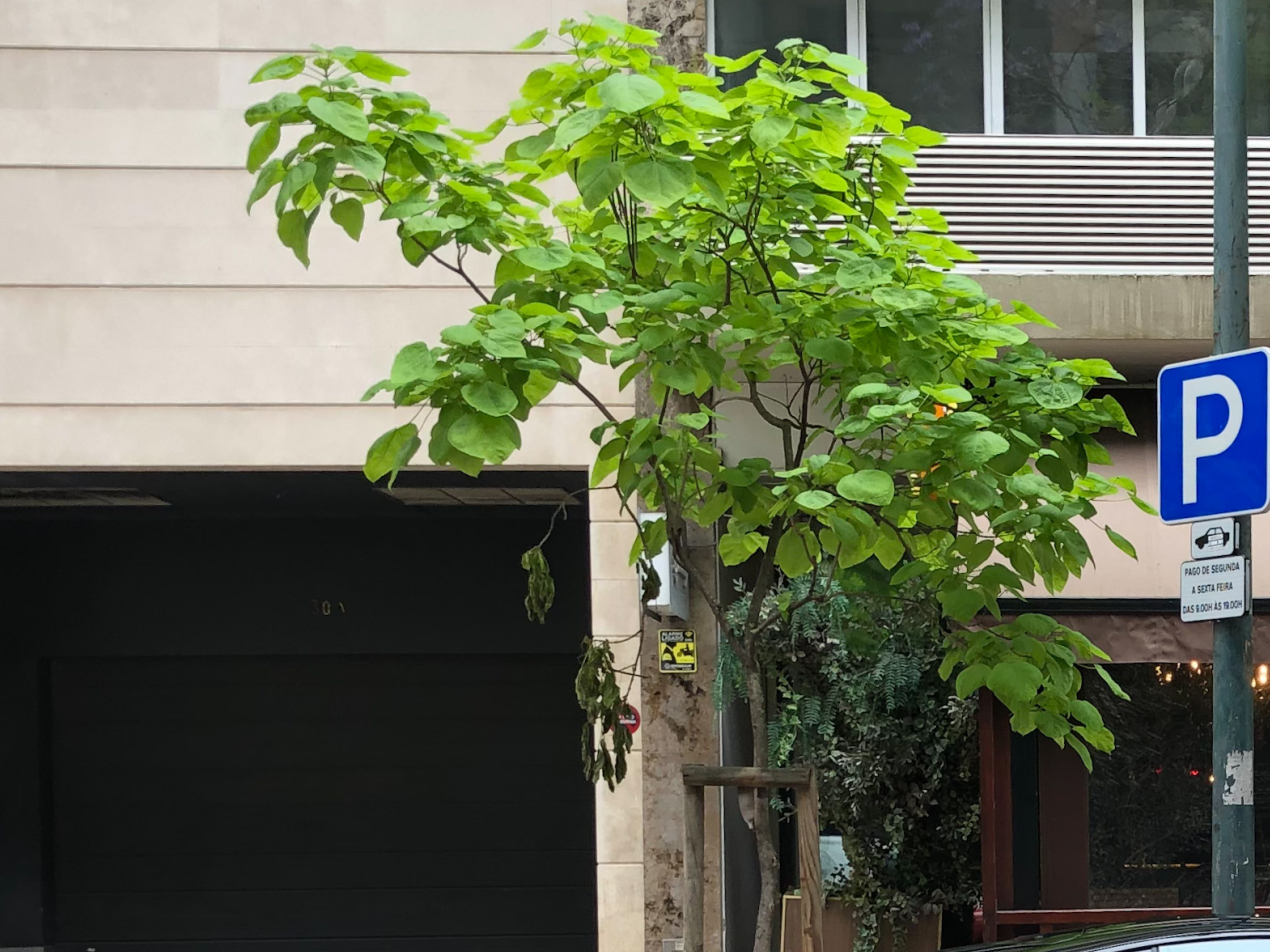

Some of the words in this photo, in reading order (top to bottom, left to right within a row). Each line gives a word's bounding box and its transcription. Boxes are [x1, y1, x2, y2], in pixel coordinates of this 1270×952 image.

[1182, 374, 1243, 505] P
[1184, 566, 1201, 577] PAGO
[1201, 565, 1210, 575] DE
[1211, 562, 1240, 574] SEGUNDA
[1191, 585, 1196, 595] A
[1197, 583, 1215, 594] SEXTA
[1216, 581, 1234, 592] FEIRA
[1182, 604, 1195, 615] DAS
